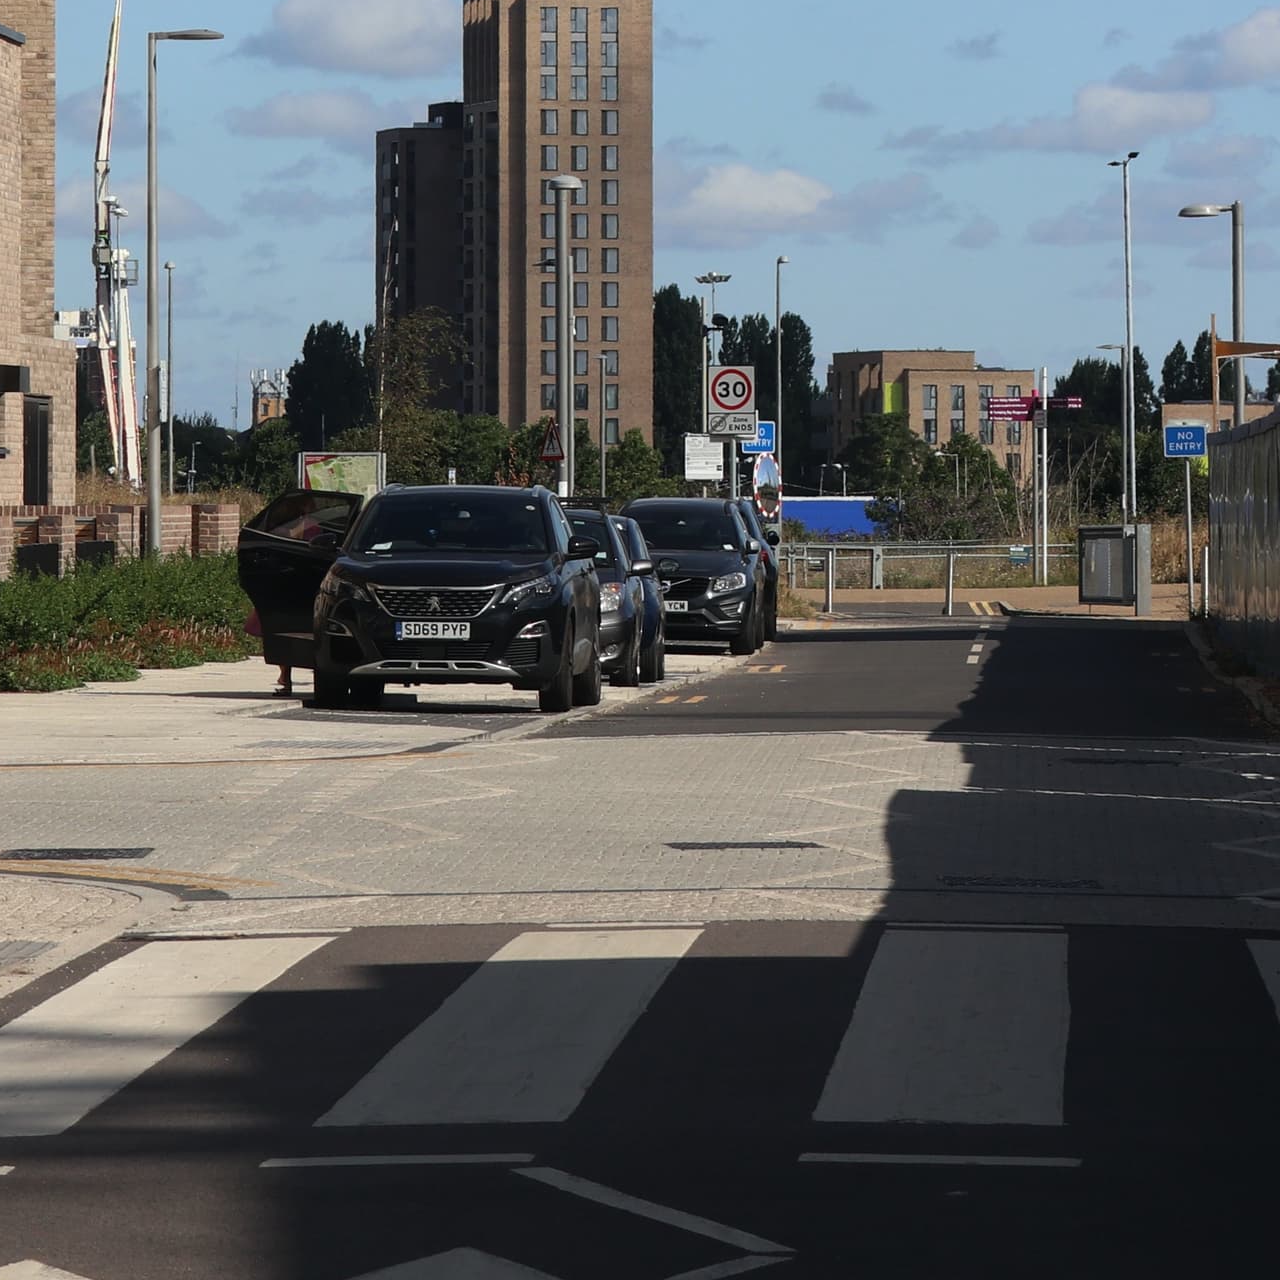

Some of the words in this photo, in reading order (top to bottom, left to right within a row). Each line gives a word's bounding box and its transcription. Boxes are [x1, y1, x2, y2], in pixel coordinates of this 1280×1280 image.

[718, 381, 746, 398] 30
[1177, 431, 1194, 440] NO
[1168, 442, 1202, 451] ENTRY
[404, 623, 439, 636] SD69
[442, 623, 468, 636] PYP
